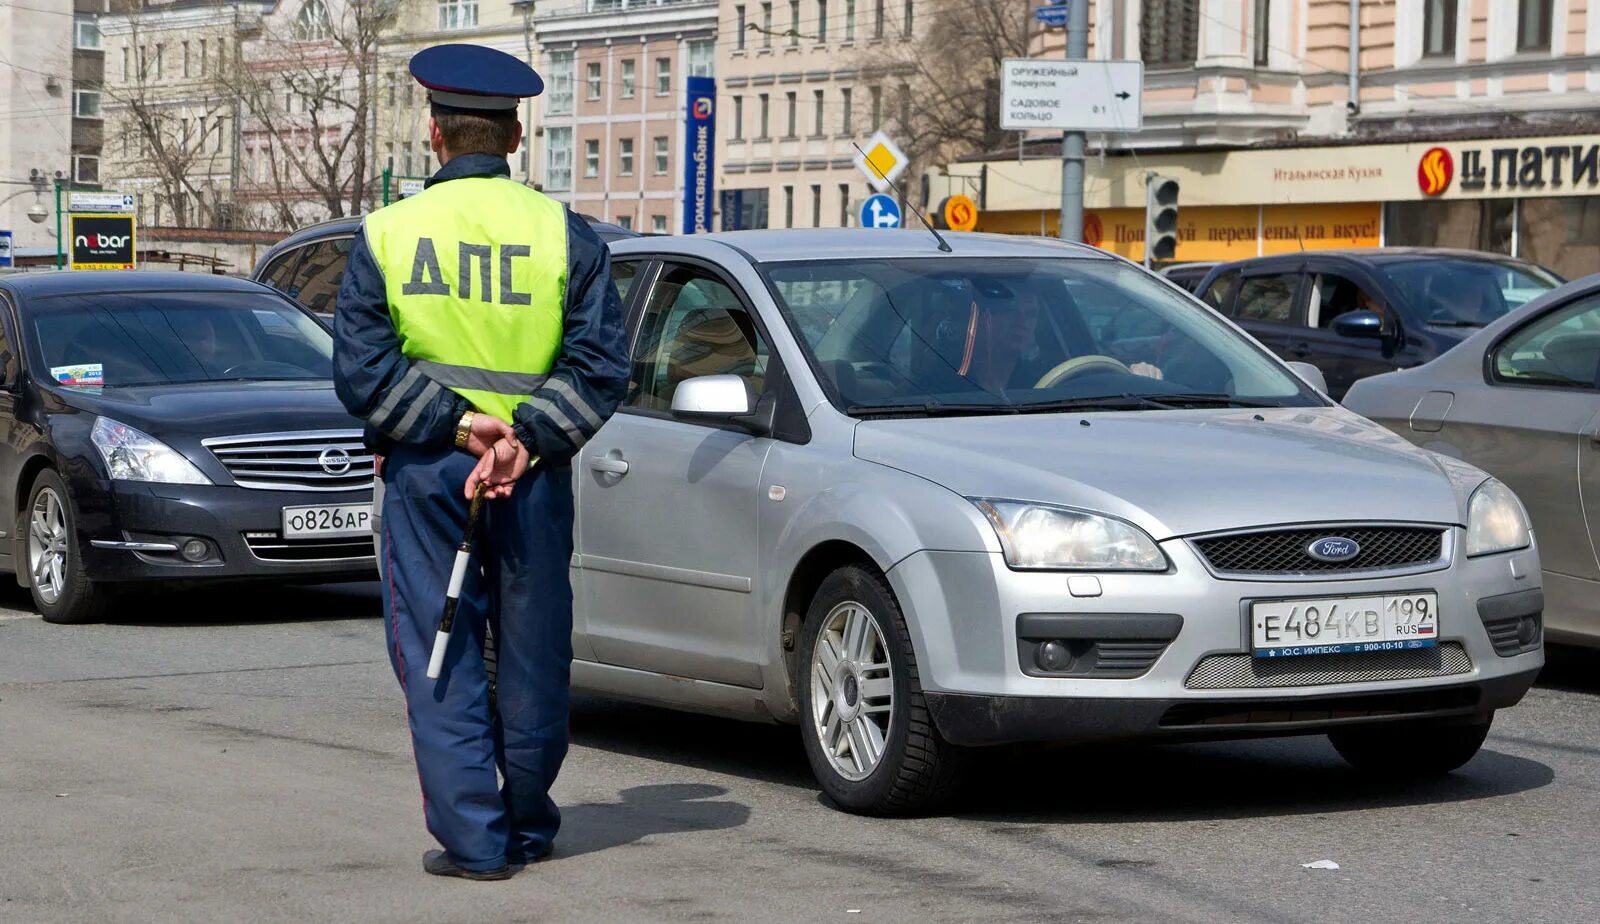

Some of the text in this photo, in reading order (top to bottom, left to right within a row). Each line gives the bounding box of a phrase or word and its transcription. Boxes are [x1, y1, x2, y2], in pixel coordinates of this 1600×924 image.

[1011, 67, 1079, 77] ОРУЖЕЙНЫЙ
[1011, 80, 1056, 88] переулок
[1010, 99, 1061, 109] САДОВОЕ
[1010, 112, 1053, 121] КОЛЬЦО
[693, 126, 708, 233] ромсвязьбанк
[1274, 166, 1383, 182] Итальянская Кухня
[1305, 224, 1325, 239] на
[1333, 219, 1376, 243] вкус!
[402, 236, 531, 305] ДПС
[292, 508, 368, 530] О826АР
[1322, 542, 1349, 555] Ford
[1264, 597, 1429, 643] Е484КВ 199
[1396, 624, 1418, 635] RUS
[1303, 645, 1341, 655] ИМПЕКС
[1364, 641, 1403, 651] 900-10-10
